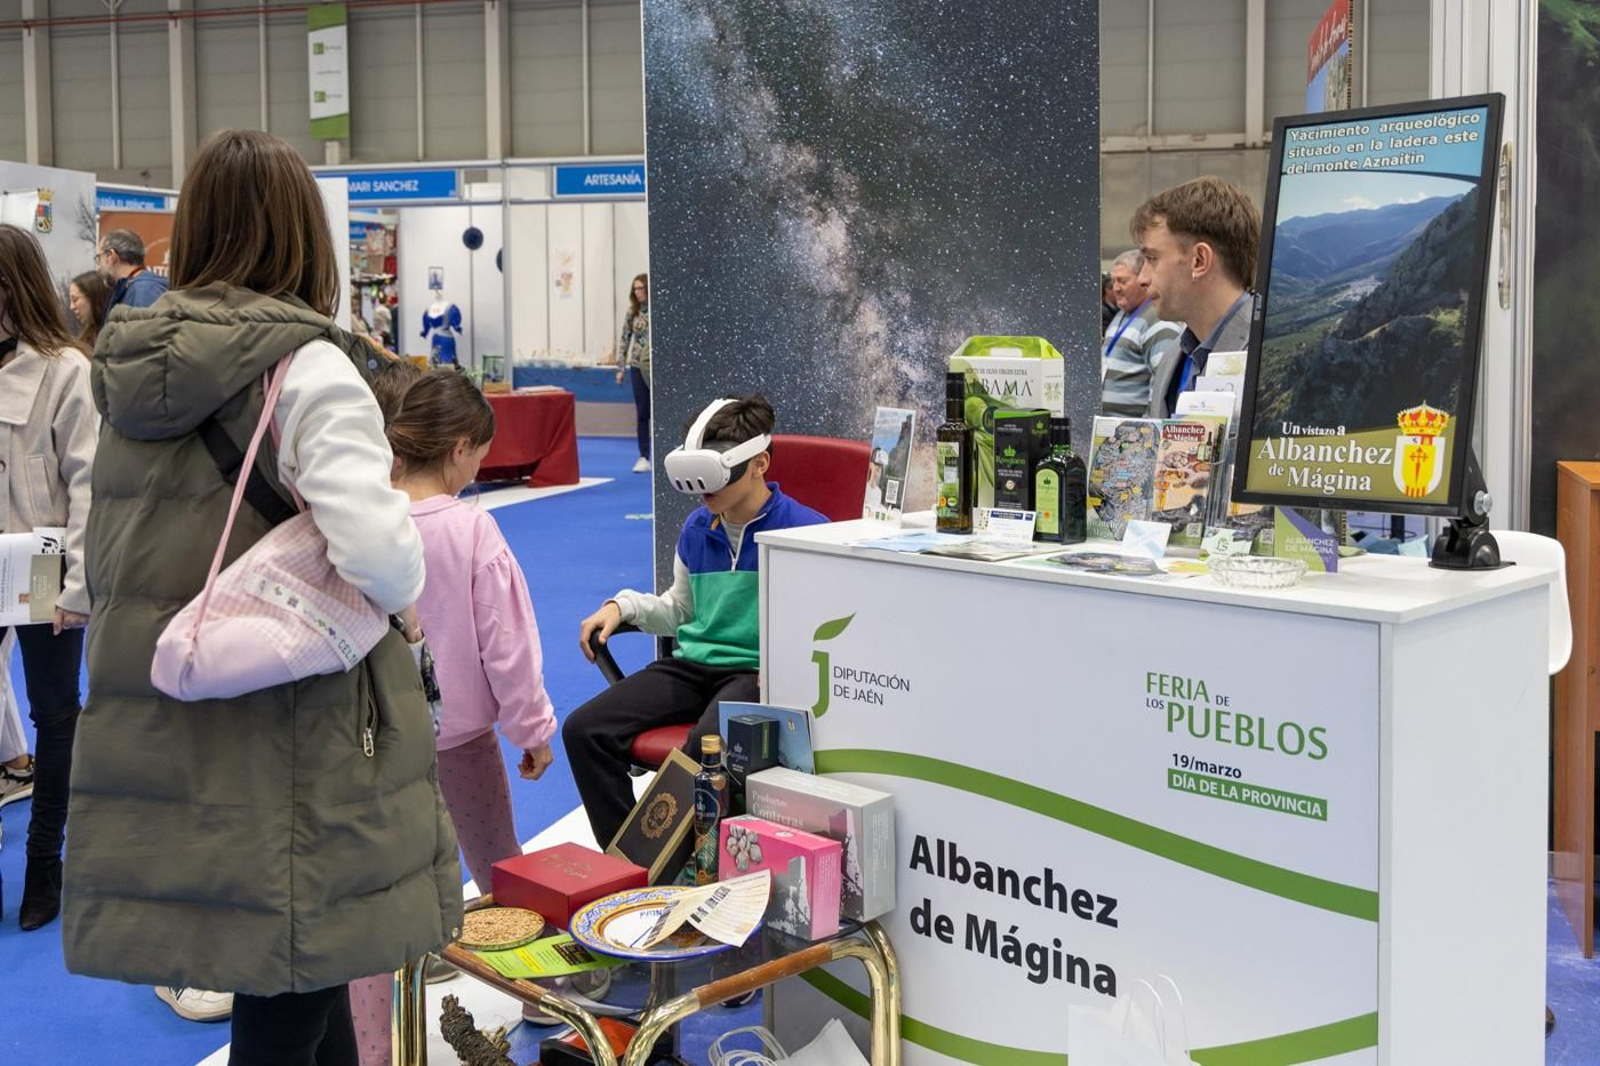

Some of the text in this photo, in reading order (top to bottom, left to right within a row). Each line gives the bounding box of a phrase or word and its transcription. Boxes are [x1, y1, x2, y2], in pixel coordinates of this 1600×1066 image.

[1290, 113, 1480, 141] Yacimiento arqueológico
[1288, 130, 1479, 159] situado en la ladera este
[584, 169, 642, 186] ARTESANÍA
[1286, 162, 1308, 175] del
[1312, 158, 1358, 173] monte
[372, 180, 419, 192] SANCHEZ
[1164, 425, 1204, 434] Albanchez
[1282, 421, 1346, 436] Un vistazo a
[1257, 436, 1393, 465] Albanchez
[1268, 463, 1371, 495] de Mágina
[1285, 537, 1334, 547] ALBANCHEZ
[1285, 544, 1298, 552] DE
[833, 666, 910, 692] DIPUTACIÓN
[1146, 672, 1230, 707] FERIA DE
[833, 684, 884, 706] DE JAÉN
[1146, 697, 1328, 761] LOS PUEBLOS
[1172, 753, 1242, 779] 19/marzo
[1172, 774, 1323, 817] DÍA DE LA PROVINCIA
[752, 802, 804, 828] Contreras
[909, 834, 1118, 928] Albanchez
[910, 897, 1117, 998] de Mágina
